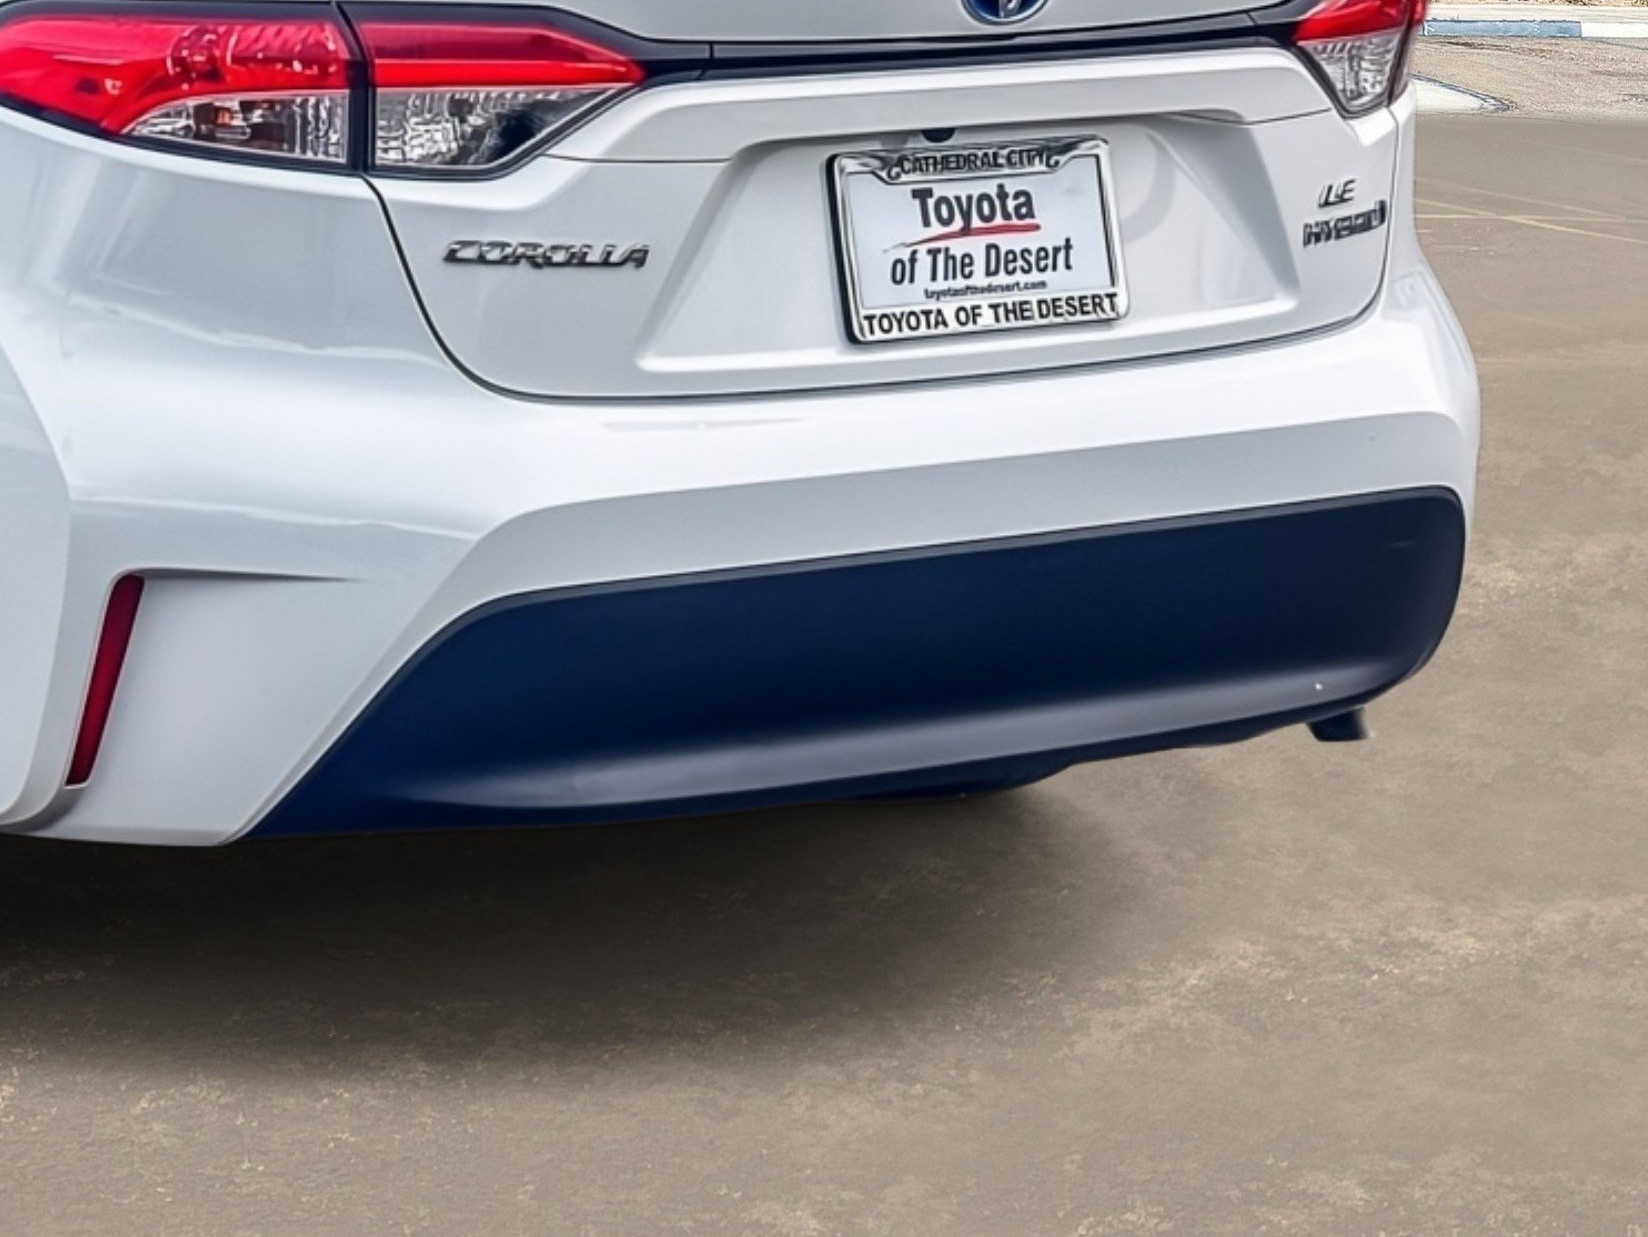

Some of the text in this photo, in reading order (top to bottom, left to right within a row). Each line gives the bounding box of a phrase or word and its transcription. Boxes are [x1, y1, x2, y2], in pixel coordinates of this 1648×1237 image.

[900, 149, 1047, 175] CATHEDRAL CITY
[911, 183, 1036, 233] Toyota
[1317, 177, 1357, 208] LE
[442, 239, 650, 270] COROLLA
[889, 237, 1073, 286] of The Desert
[863, 292, 1119, 337] TOYOTA OF THE DESERT
